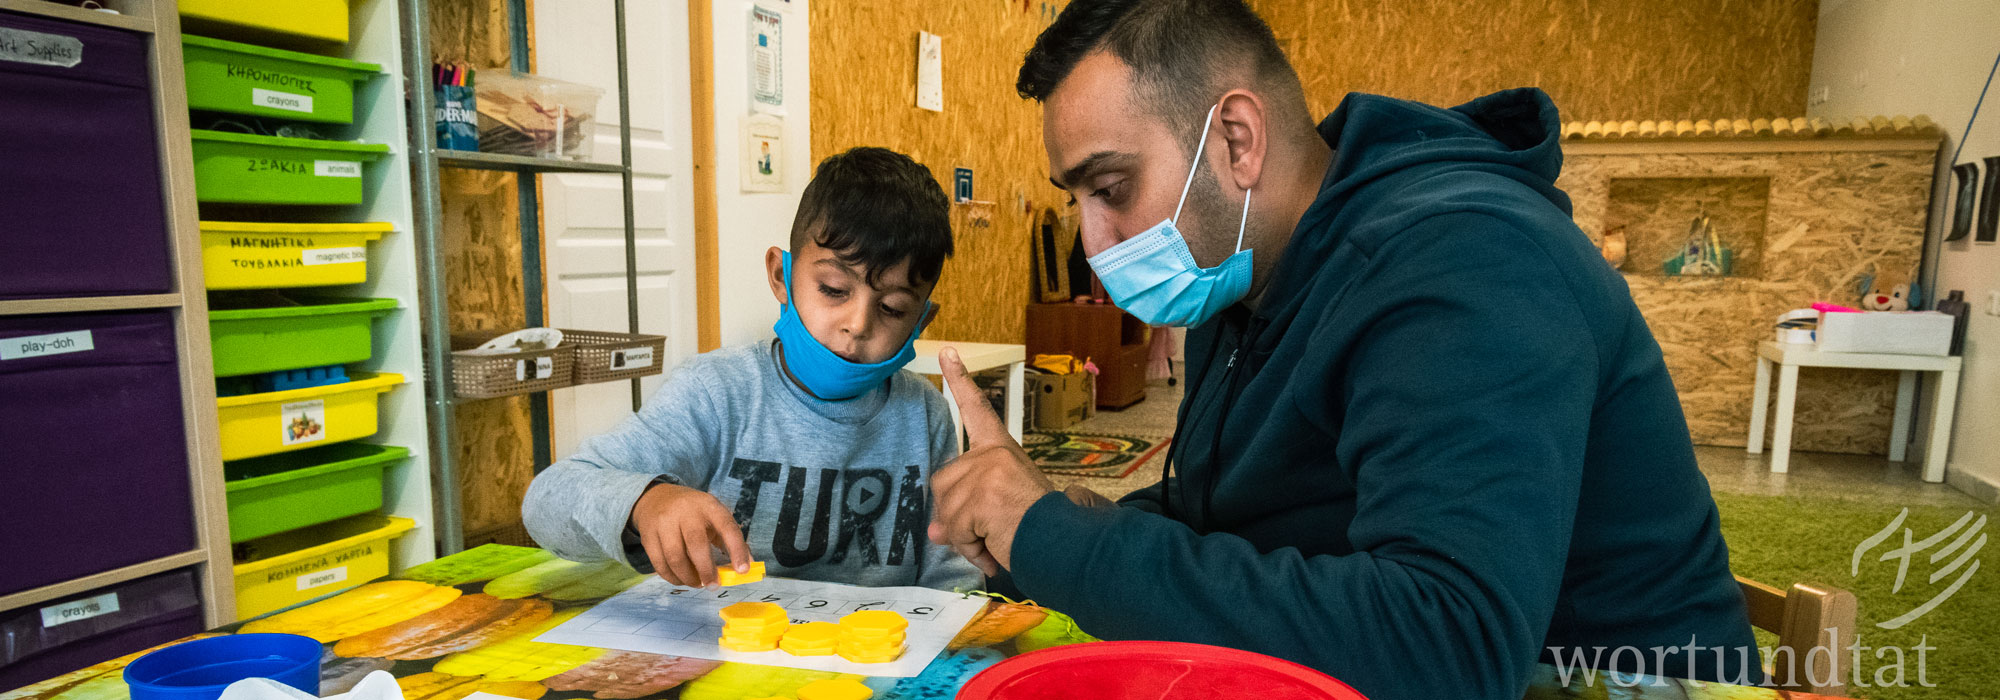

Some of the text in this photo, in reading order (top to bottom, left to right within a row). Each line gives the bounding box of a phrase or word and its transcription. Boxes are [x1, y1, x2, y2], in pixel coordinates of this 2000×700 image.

[27, 40, 72, 61] Supplies
[266, 95, 300, 108] crayons
[327, 164, 355, 174] animals
[315, 252, 350, 262] magnetic
[21, 336, 75, 354] play-doh
[728, 457, 923, 568] TURN
[309, 573, 335, 586] papers
[62, 603, 101, 618] crayons
